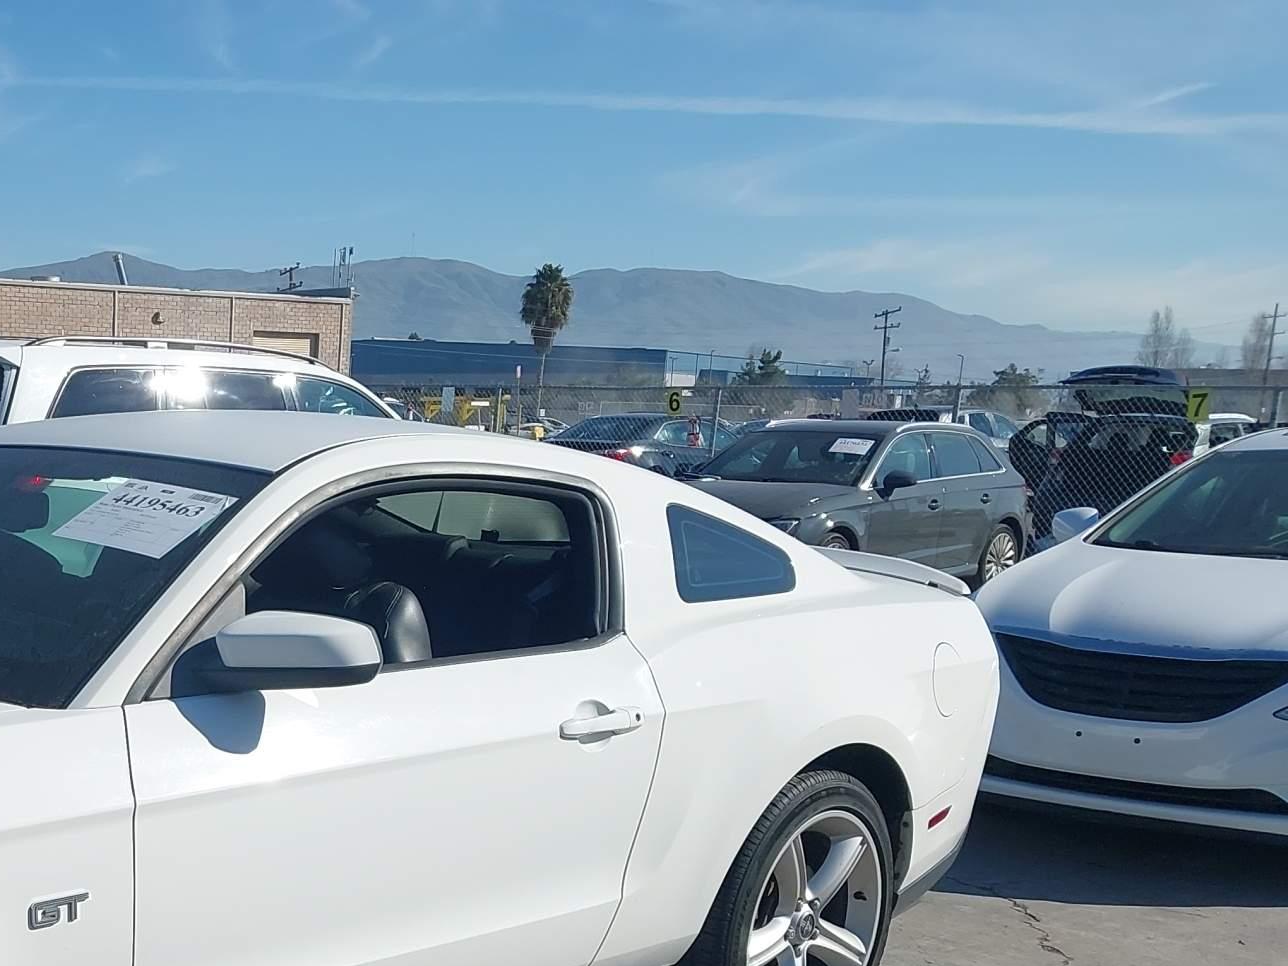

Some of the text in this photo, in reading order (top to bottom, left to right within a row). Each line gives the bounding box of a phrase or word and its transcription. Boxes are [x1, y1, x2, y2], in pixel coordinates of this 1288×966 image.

[669, 391, 681, 411] 6
[1192, 393, 1209, 417] 7
[113, 492, 206, 518] 44195463
[27, 892, 90, 931] GT
